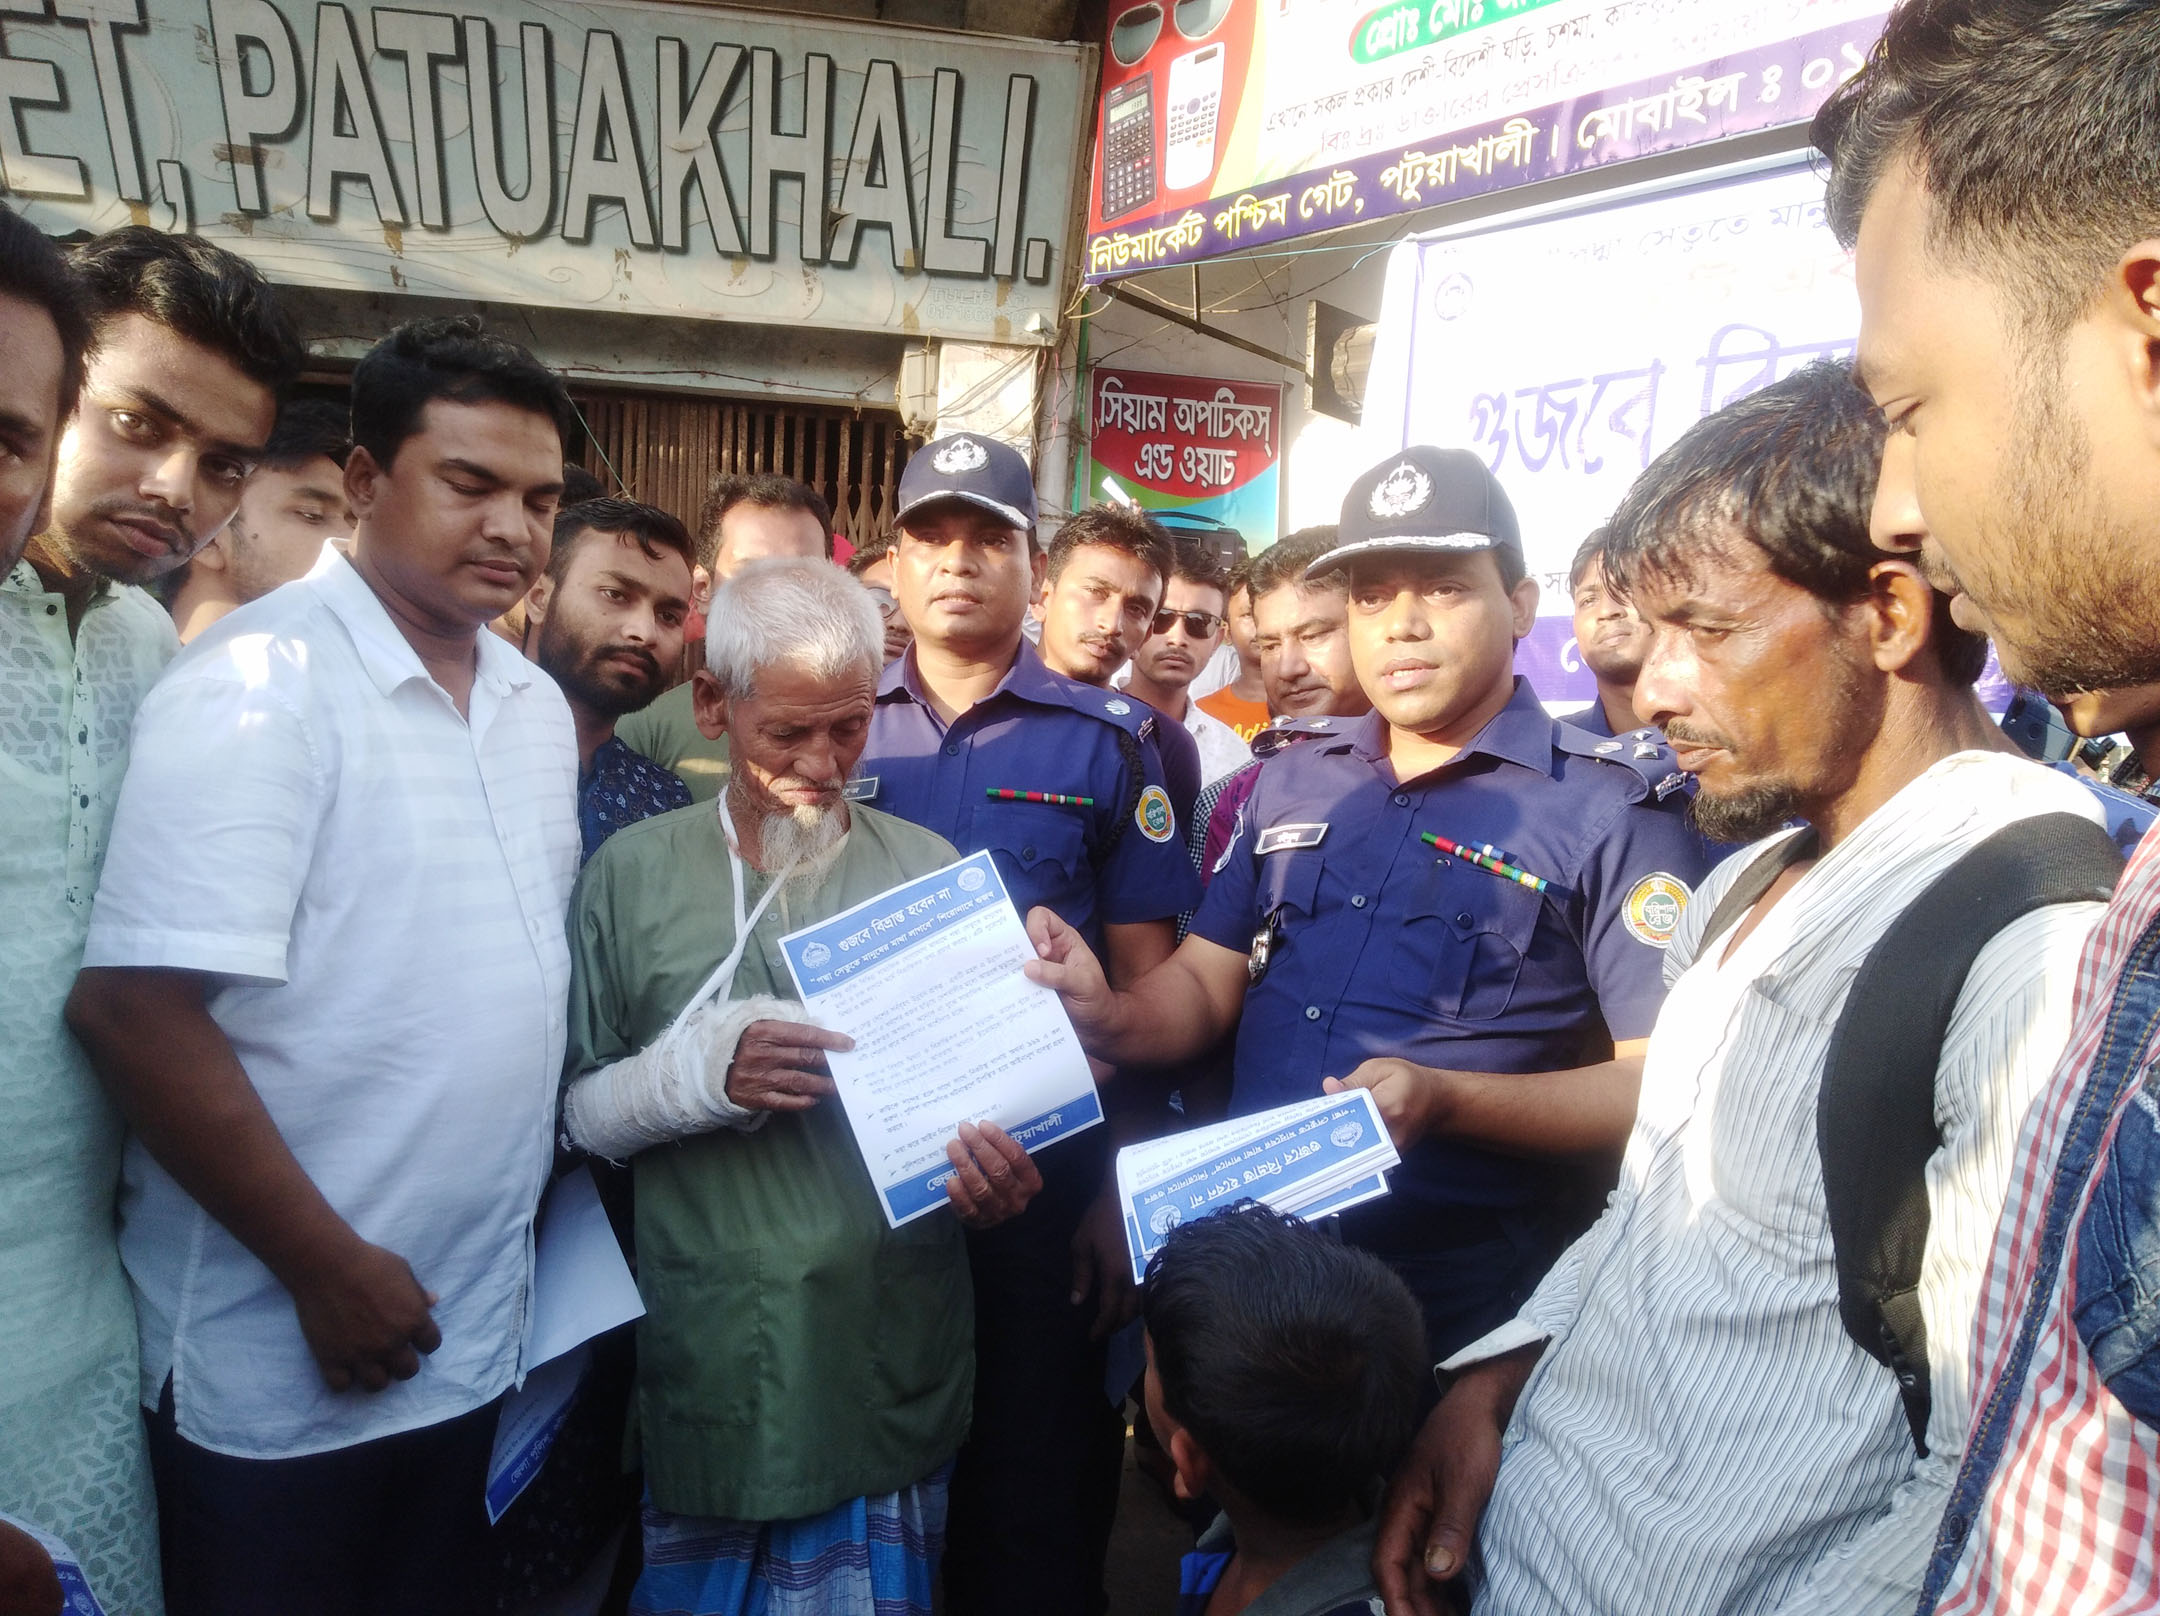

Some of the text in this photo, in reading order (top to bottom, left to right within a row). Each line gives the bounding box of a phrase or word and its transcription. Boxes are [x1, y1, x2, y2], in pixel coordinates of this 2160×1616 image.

[1313, 90, 1350, 117] সকল
[207, 0, 1051, 283] PATUAKHALI.
[1089, 209, 1208, 275] নিউমার্কেট
[1213, 193, 1293, 240] পশ্চিম
[1299, 170, 1365, 218] গেট,
[1379, 118, 1541, 200] পটুয়াখালী
[1577, 71, 1748, 149] মোবাইল
[1639, 213, 1752, 256] সেতুতে
[1099, 376, 1272, 458] সিয়াম অপটিকস্
[1470, 357, 1667, 476] গুজবে
[1179, 446, 1238, 488] ওয়াচ
[834, 958, 861, 977] সেতুতে
[861, 943, 890, 962] মানুষের
[889, 933, 908, 946] মাথা
[936, 900, 974, 923] শিরোনামে
[974, 891, 994, 904] গুজব
[838, 887, 952, 951] গুজবে বিভ্রান্ত হবেন না
[1010, 1112, 1064, 1146] টুয়াখালী
[1243, 1146, 1264, 1160] মাথা
[1264, 1131, 1297, 1150] মানুষের
[1167, 1170, 1209, 1194] শিরোনামে
[1189, 1140, 1322, 1209] গুজবে বিভ্রান্ত হবেন না
